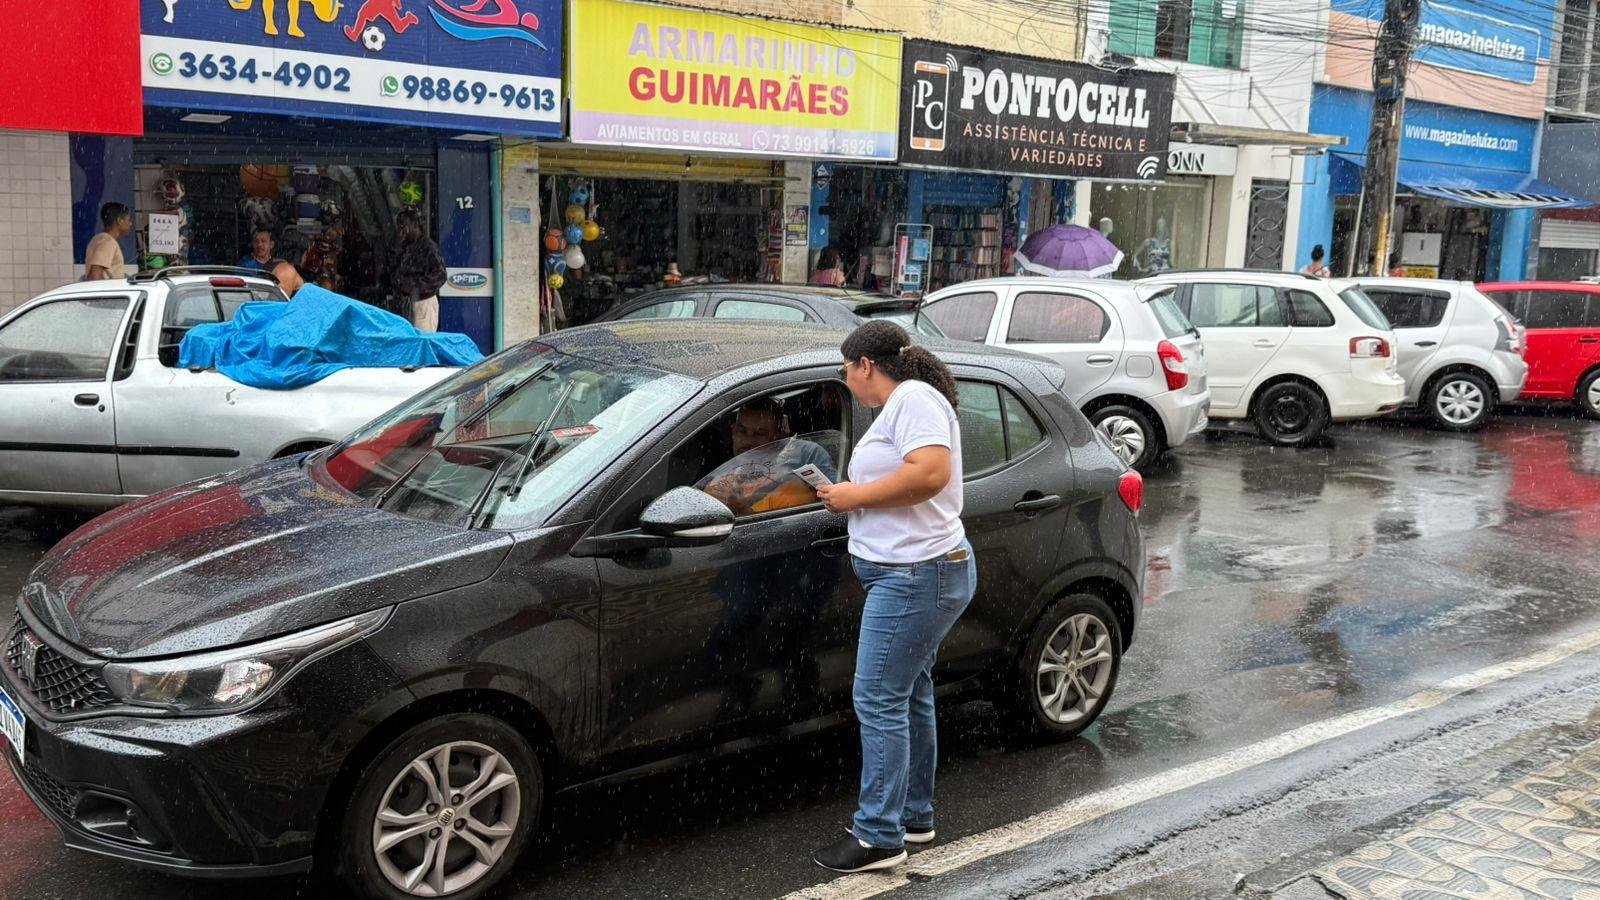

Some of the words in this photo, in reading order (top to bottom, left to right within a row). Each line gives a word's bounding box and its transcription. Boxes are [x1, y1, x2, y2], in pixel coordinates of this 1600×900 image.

[629, 23, 856, 77] ARMARINHO
[1420, 22, 1526, 62] magazineluiza
[179, 52, 351, 93] 3634-4902
[403, 75, 556, 111] 98869-9613
[629, 66, 849, 116] GUIMARÃES
[960, 66, 1150, 128] PONTOCELL
[597, 123, 679, 144] AVIAMENTOS
[682, 129, 699, 145] EM
[703, 130, 741, 147] GERAL
[772, 133, 791, 151] 73
[794, 135, 875, 156] 99141-5926
[962, 122, 1065, 145] ASSISTÊNCIA
[1072, 128, 1134, 151] TÉCNICA
[1138, 138, 1147, 151] E
[1404, 124, 1518, 152] www.magazineluiza.com
[1010, 147, 1103, 168] VARIEDADES
[456, 196, 474, 210] 12
